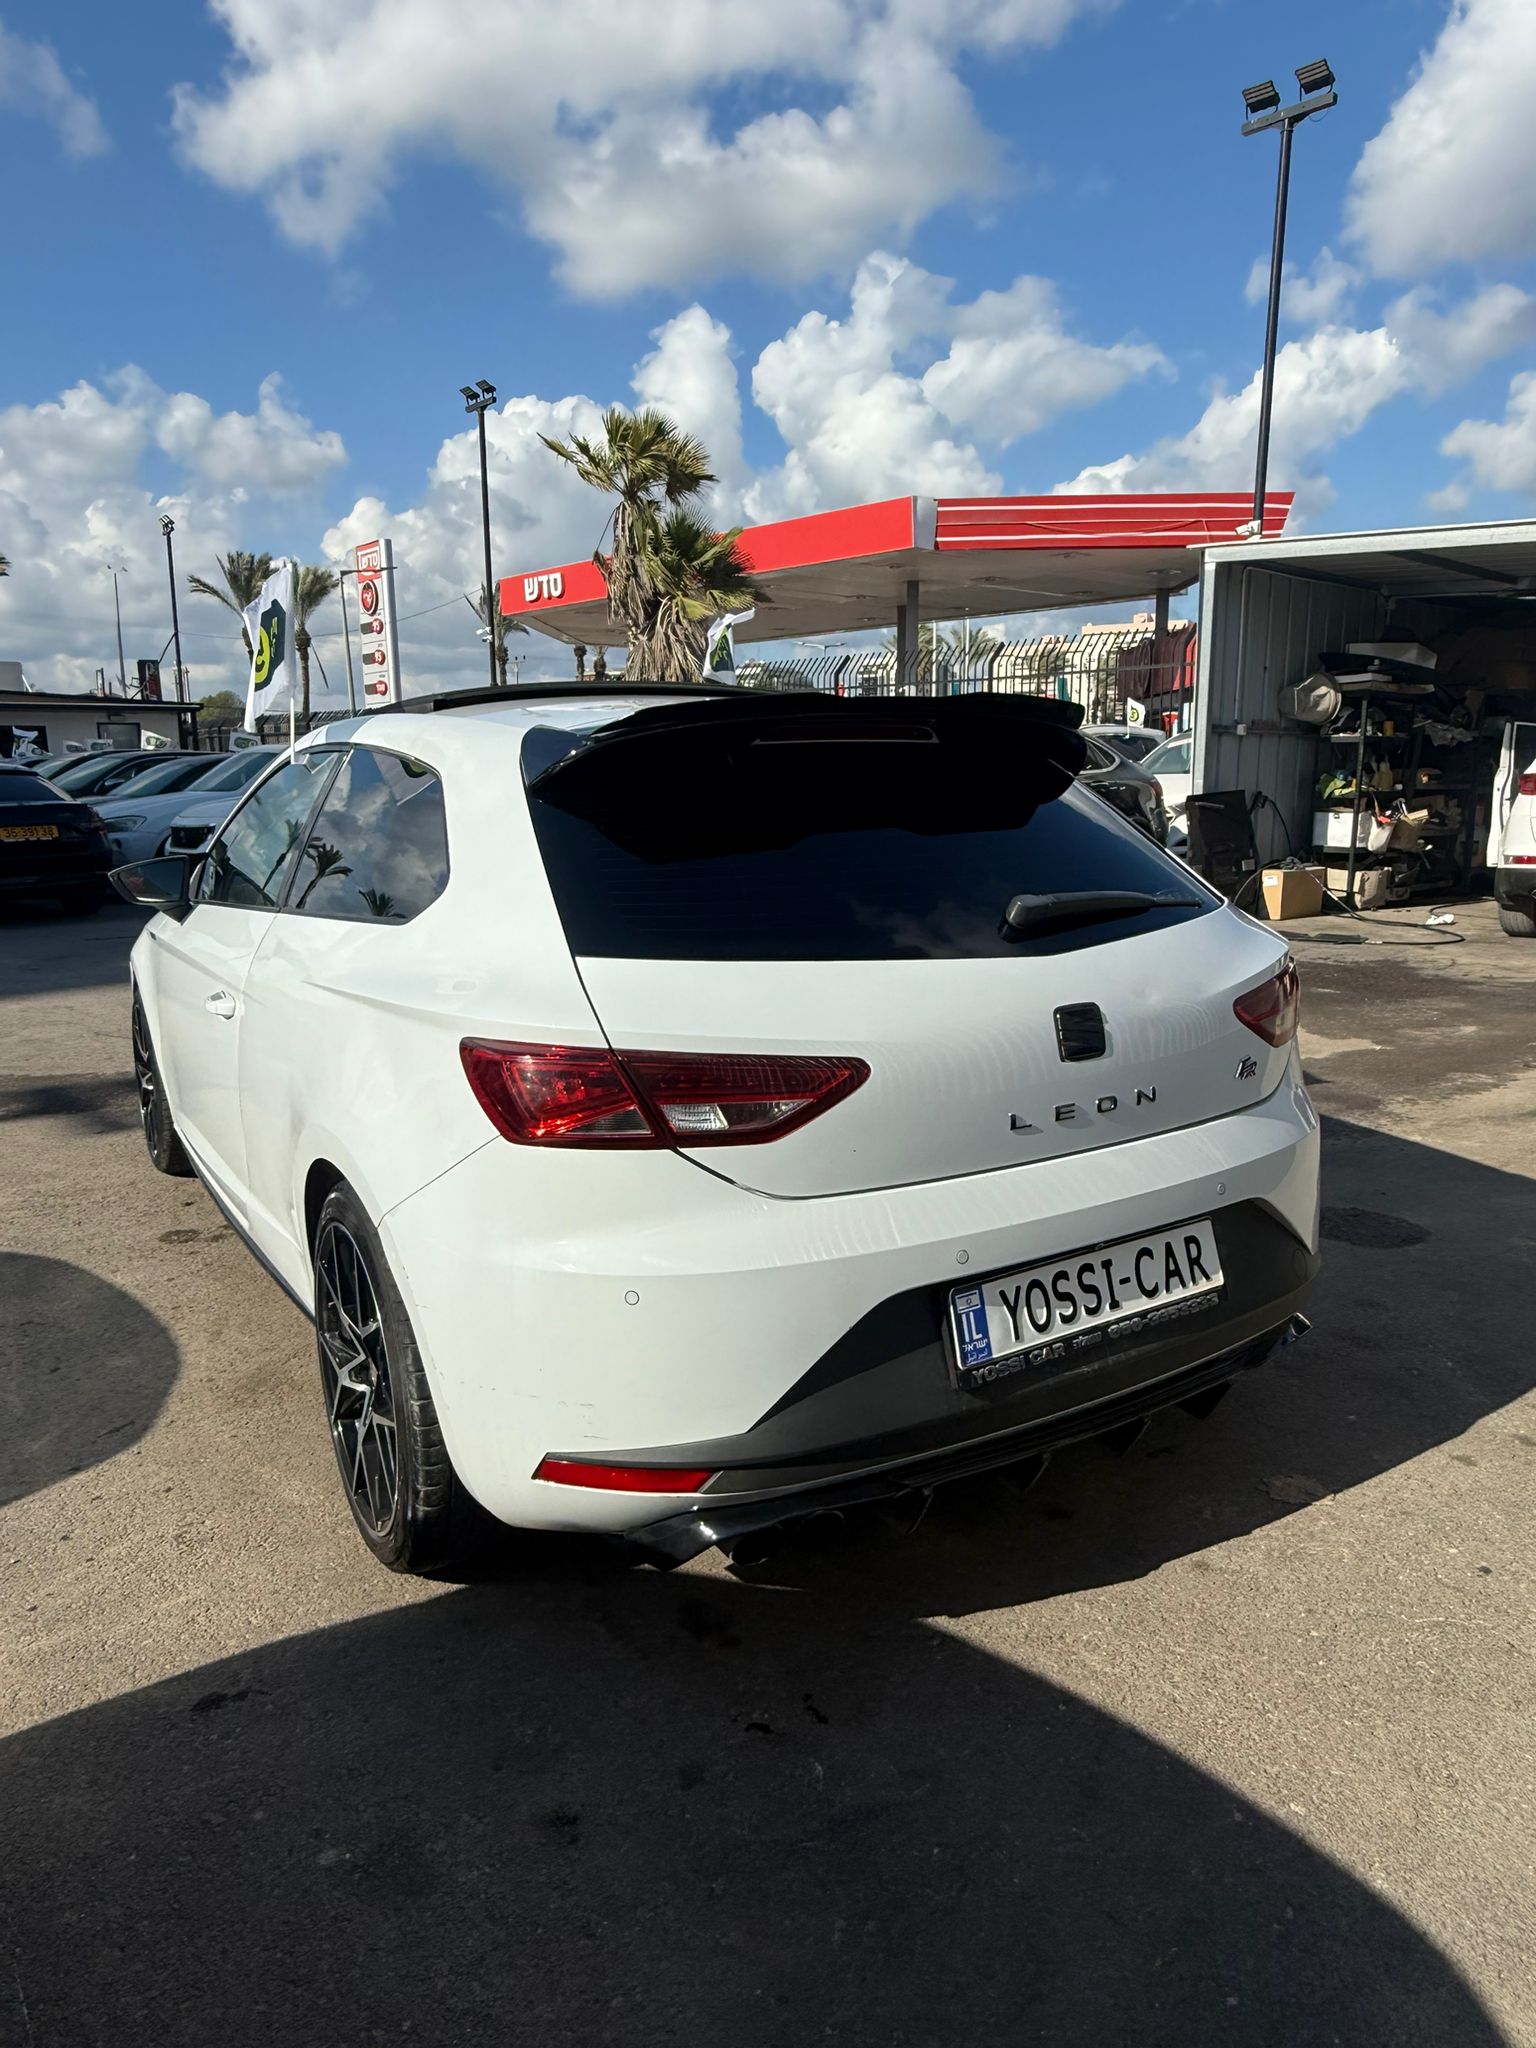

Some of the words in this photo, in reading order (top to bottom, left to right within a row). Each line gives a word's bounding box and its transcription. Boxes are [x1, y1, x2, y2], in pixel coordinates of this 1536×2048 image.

[361, 552, 379, 570] סדש
[524, 571, 563, 602] סדש
[1008, 1086, 1157, 1131] LEON
[998, 1234, 1212, 1342] YOSSI-CAR
[961, 1311, 983, 1342] IL
[962, 1338, 988, 1353] ישראל
[972, 1356, 1026, 1384] YOSSI
[1029, 1342, 1065, 1365] CAR
